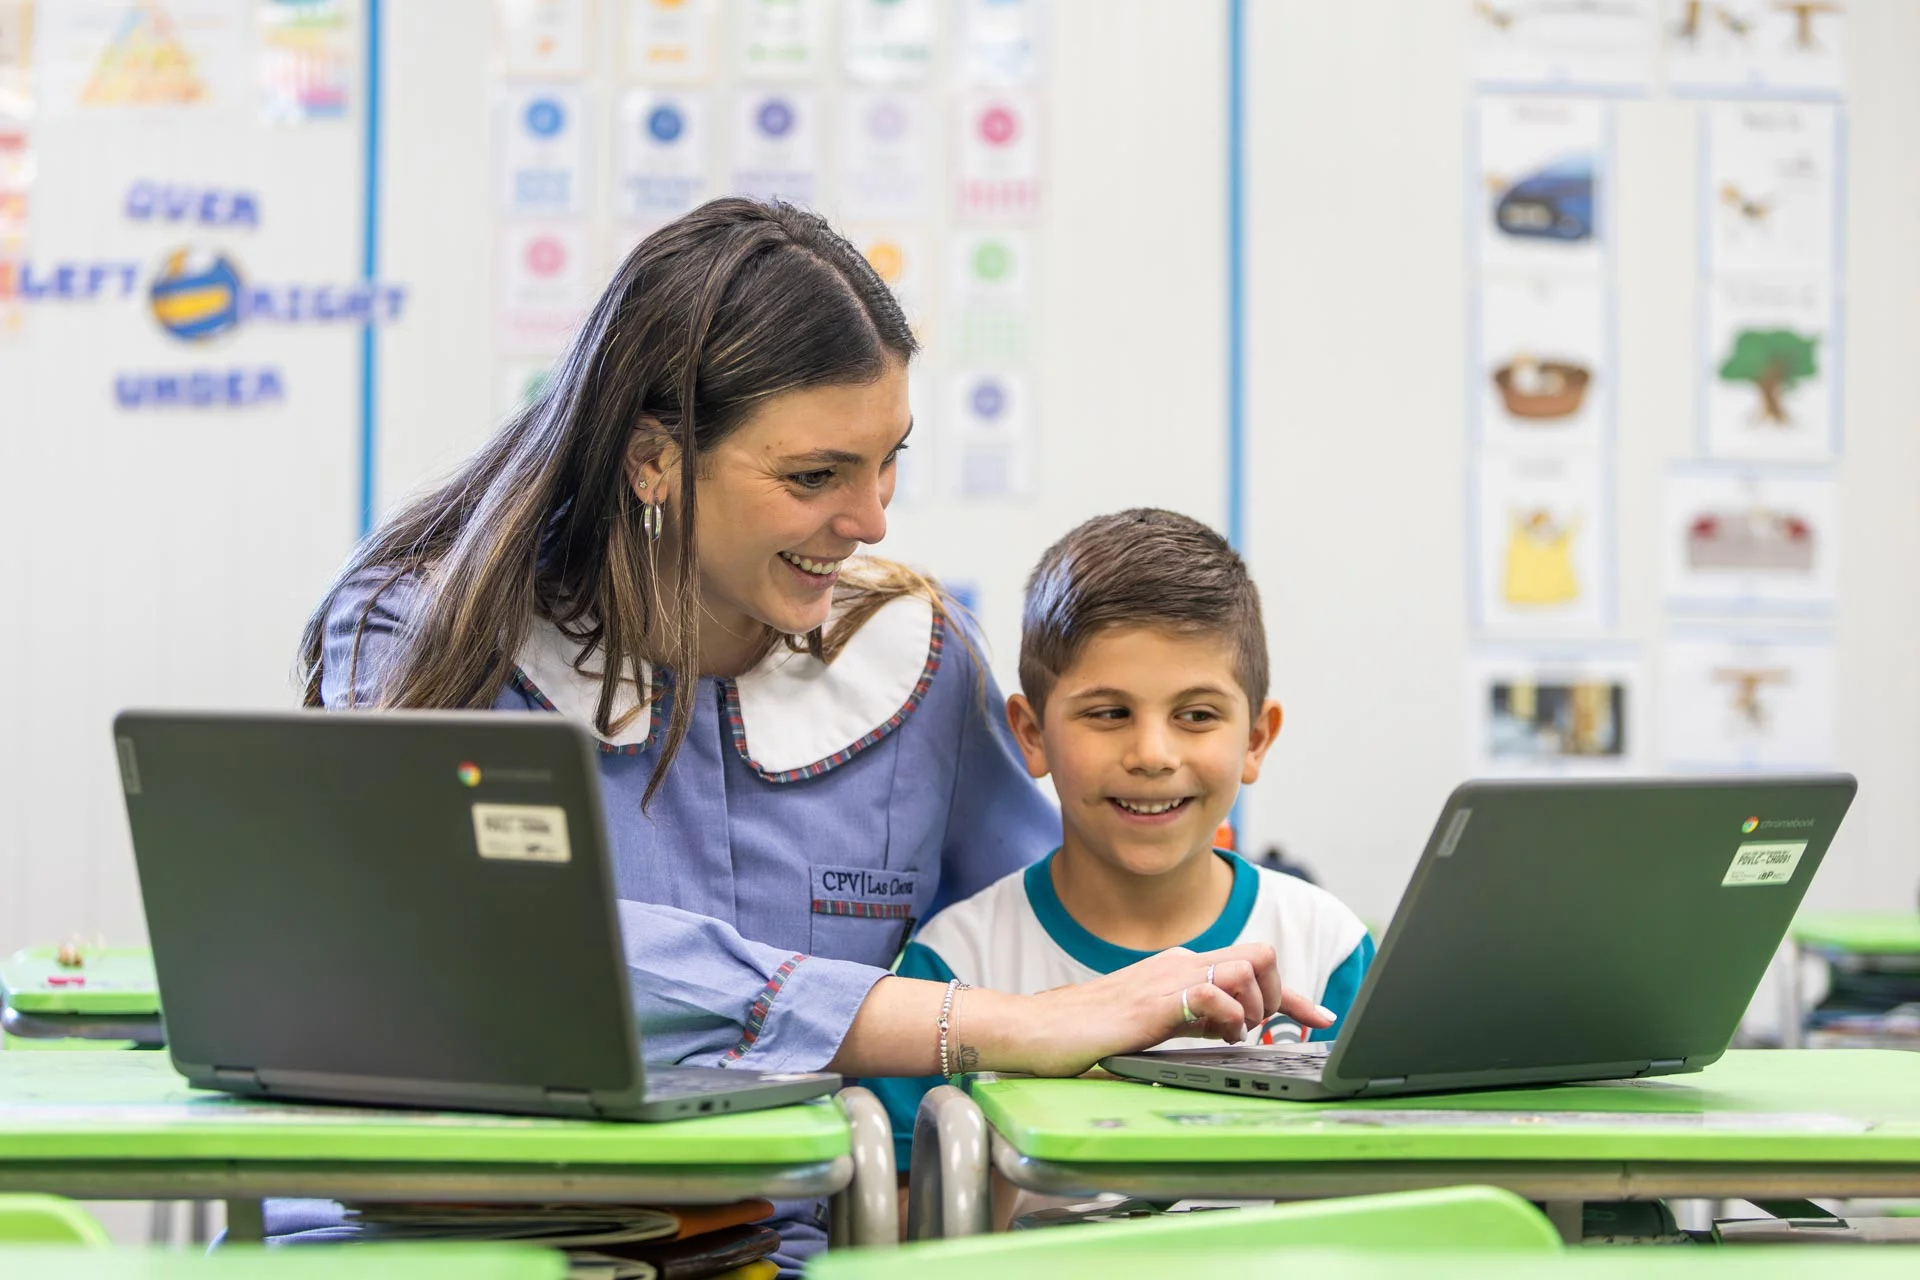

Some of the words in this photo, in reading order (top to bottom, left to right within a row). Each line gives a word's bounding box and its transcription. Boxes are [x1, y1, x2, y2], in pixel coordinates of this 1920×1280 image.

[124, 182, 259, 228] OVER
[19, 261, 139, 299] LEFT
[244, 286, 407, 322] RIGHT
[114, 367, 285, 410] UNDER
[1761, 817, 1815, 829] chromebook
[822, 871, 860, 893] CPV
